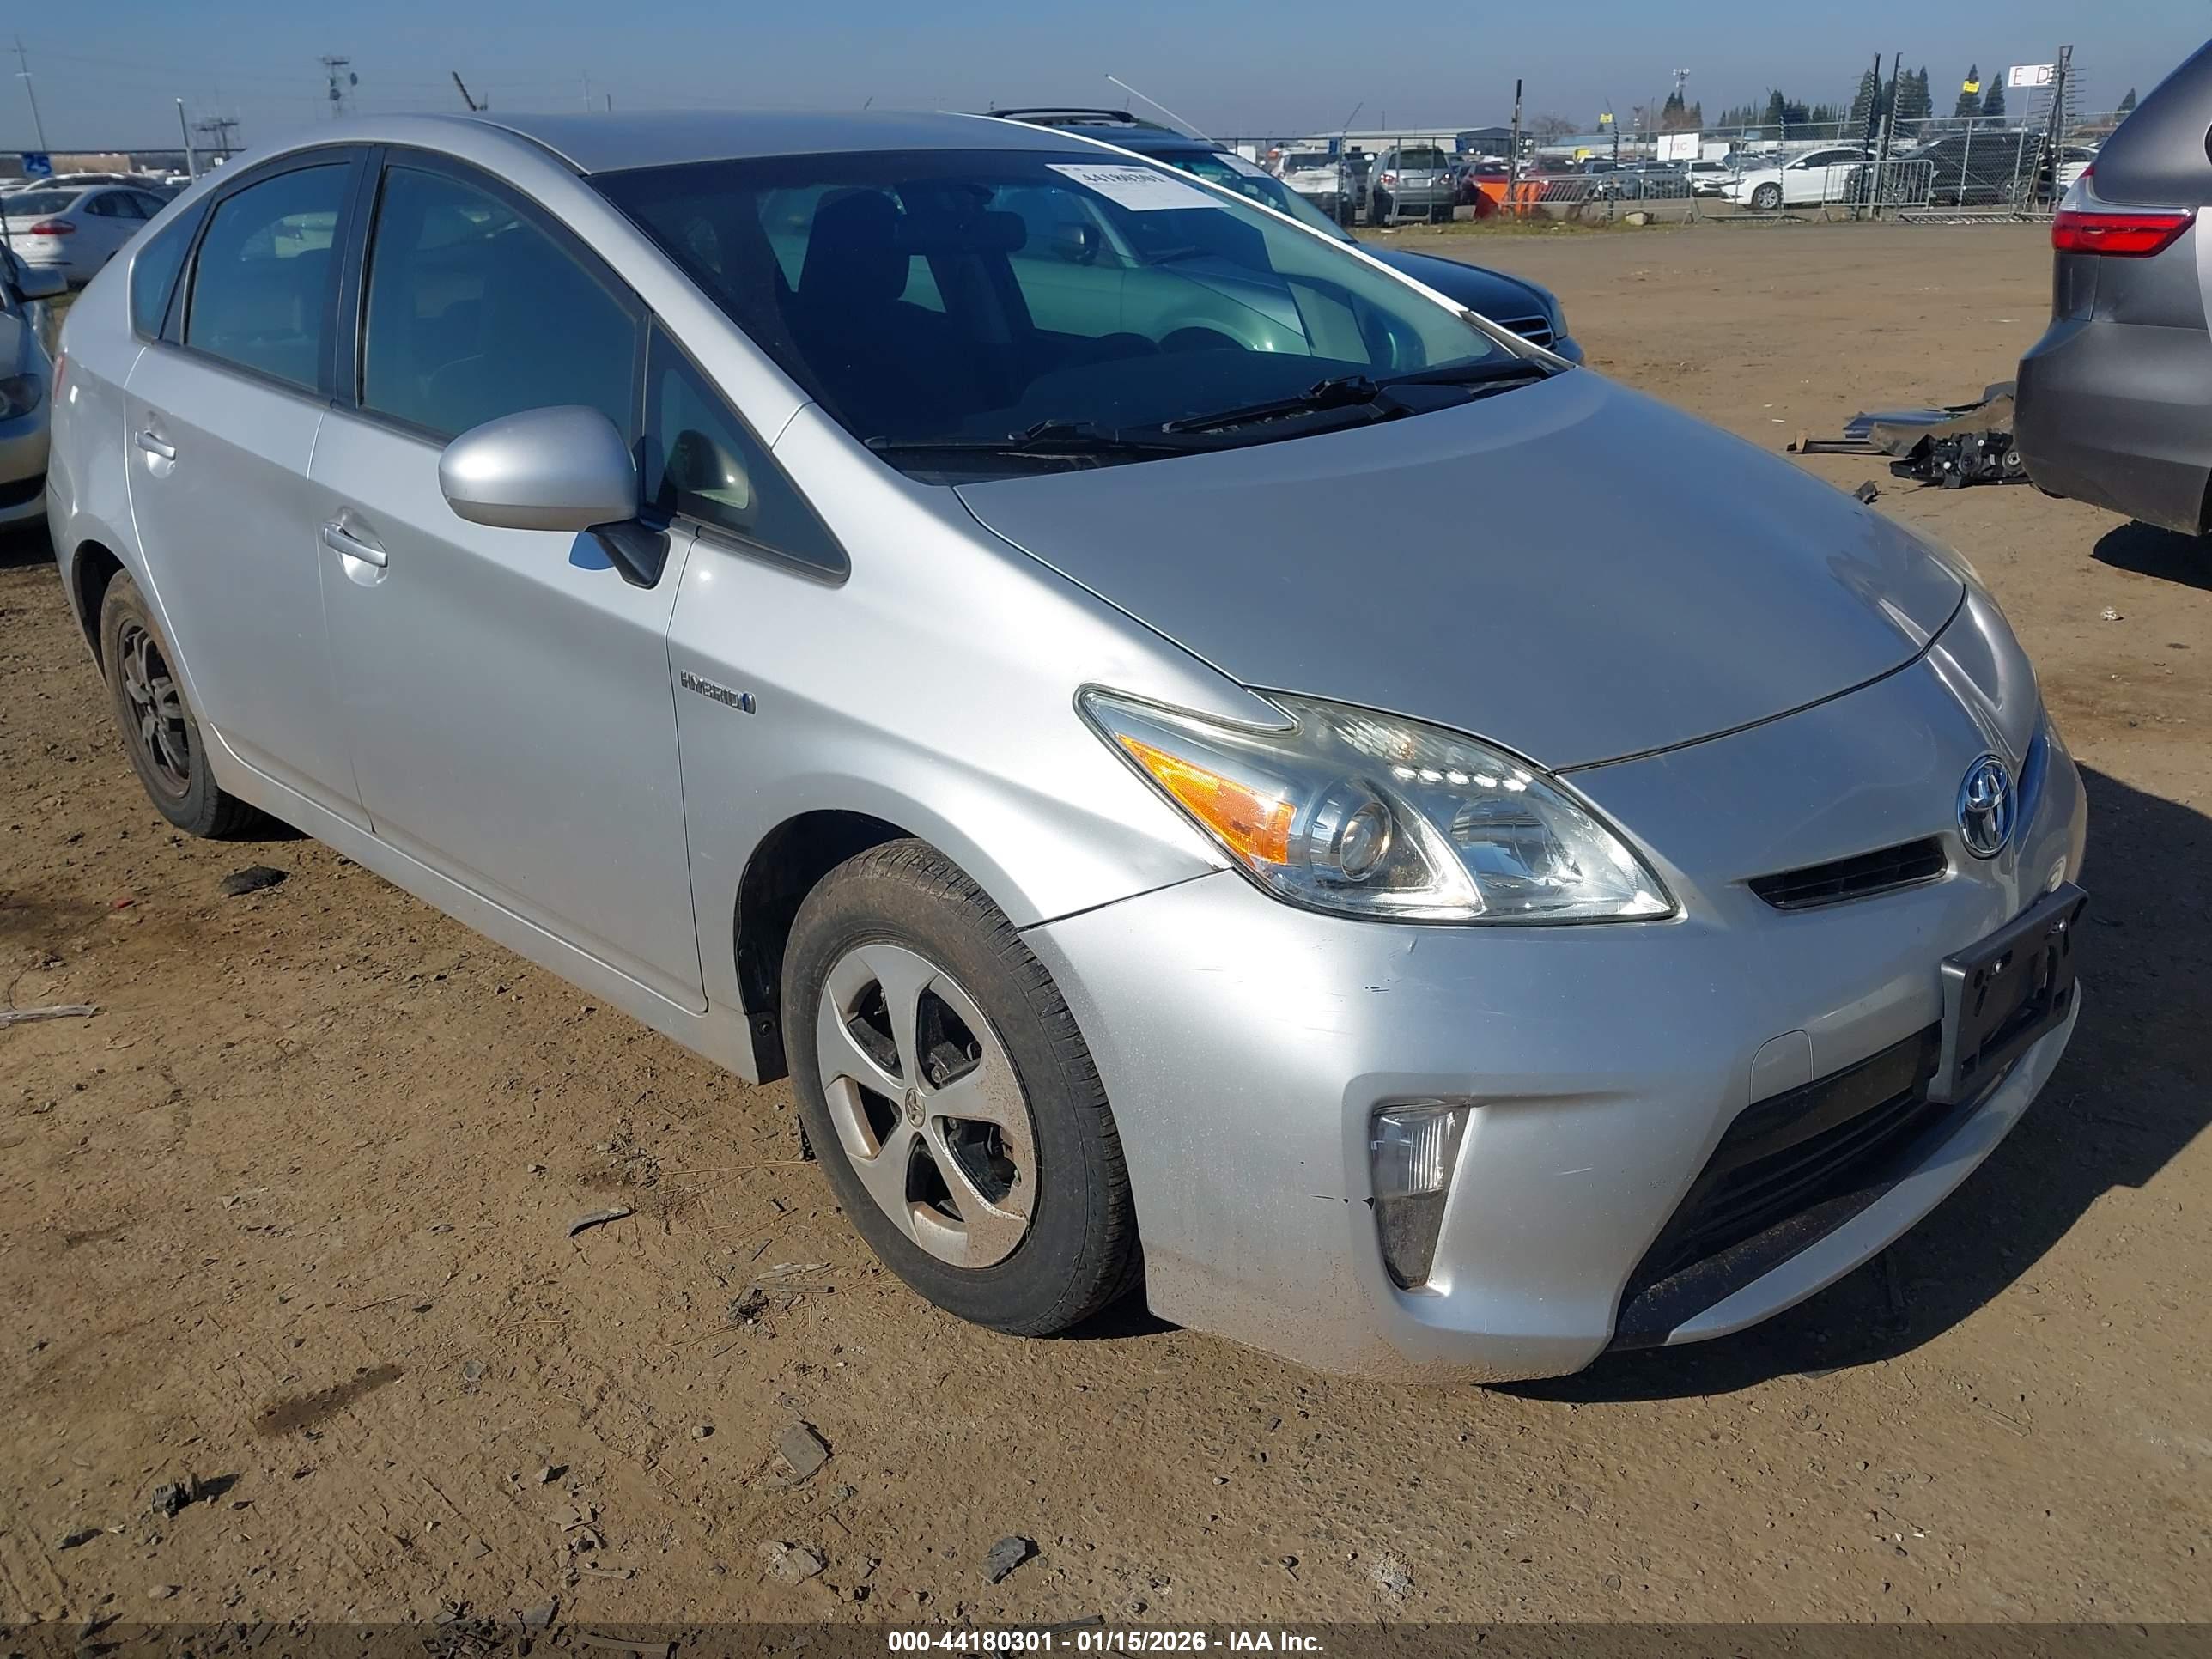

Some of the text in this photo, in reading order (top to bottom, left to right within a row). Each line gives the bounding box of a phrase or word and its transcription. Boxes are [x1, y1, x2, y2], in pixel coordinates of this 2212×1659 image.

[2014, 66, 2050, 85] E D
[26, 154, 52, 175] 25
[681, 670, 743, 710] HYBRID
